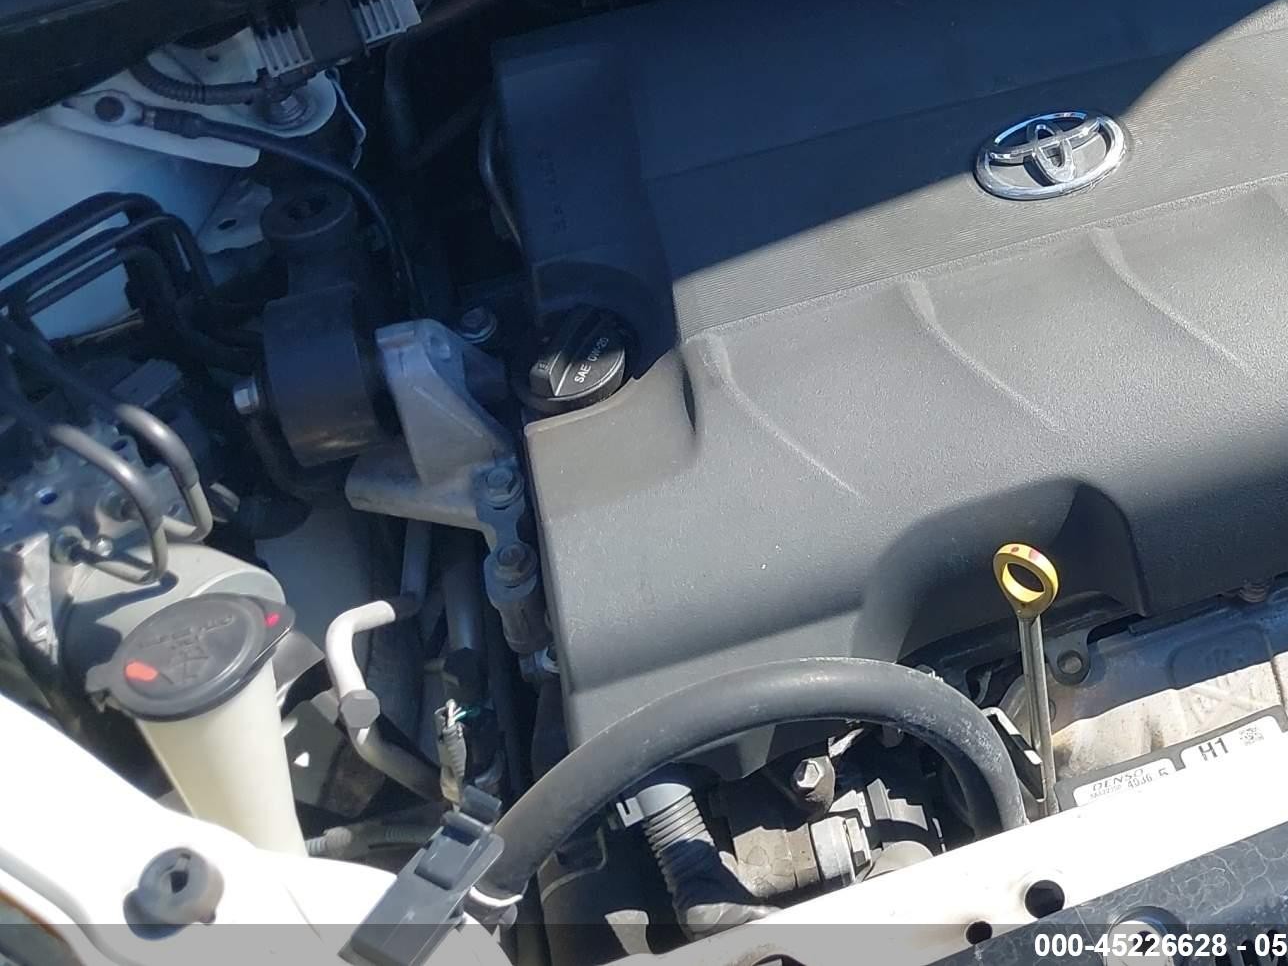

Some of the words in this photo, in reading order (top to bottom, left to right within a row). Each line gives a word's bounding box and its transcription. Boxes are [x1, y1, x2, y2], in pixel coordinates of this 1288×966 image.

[574, 363, 592, 383] SAE
[1198, 737, 1229, 761] H1
[1091, 768, 1144, 792] DENSO
